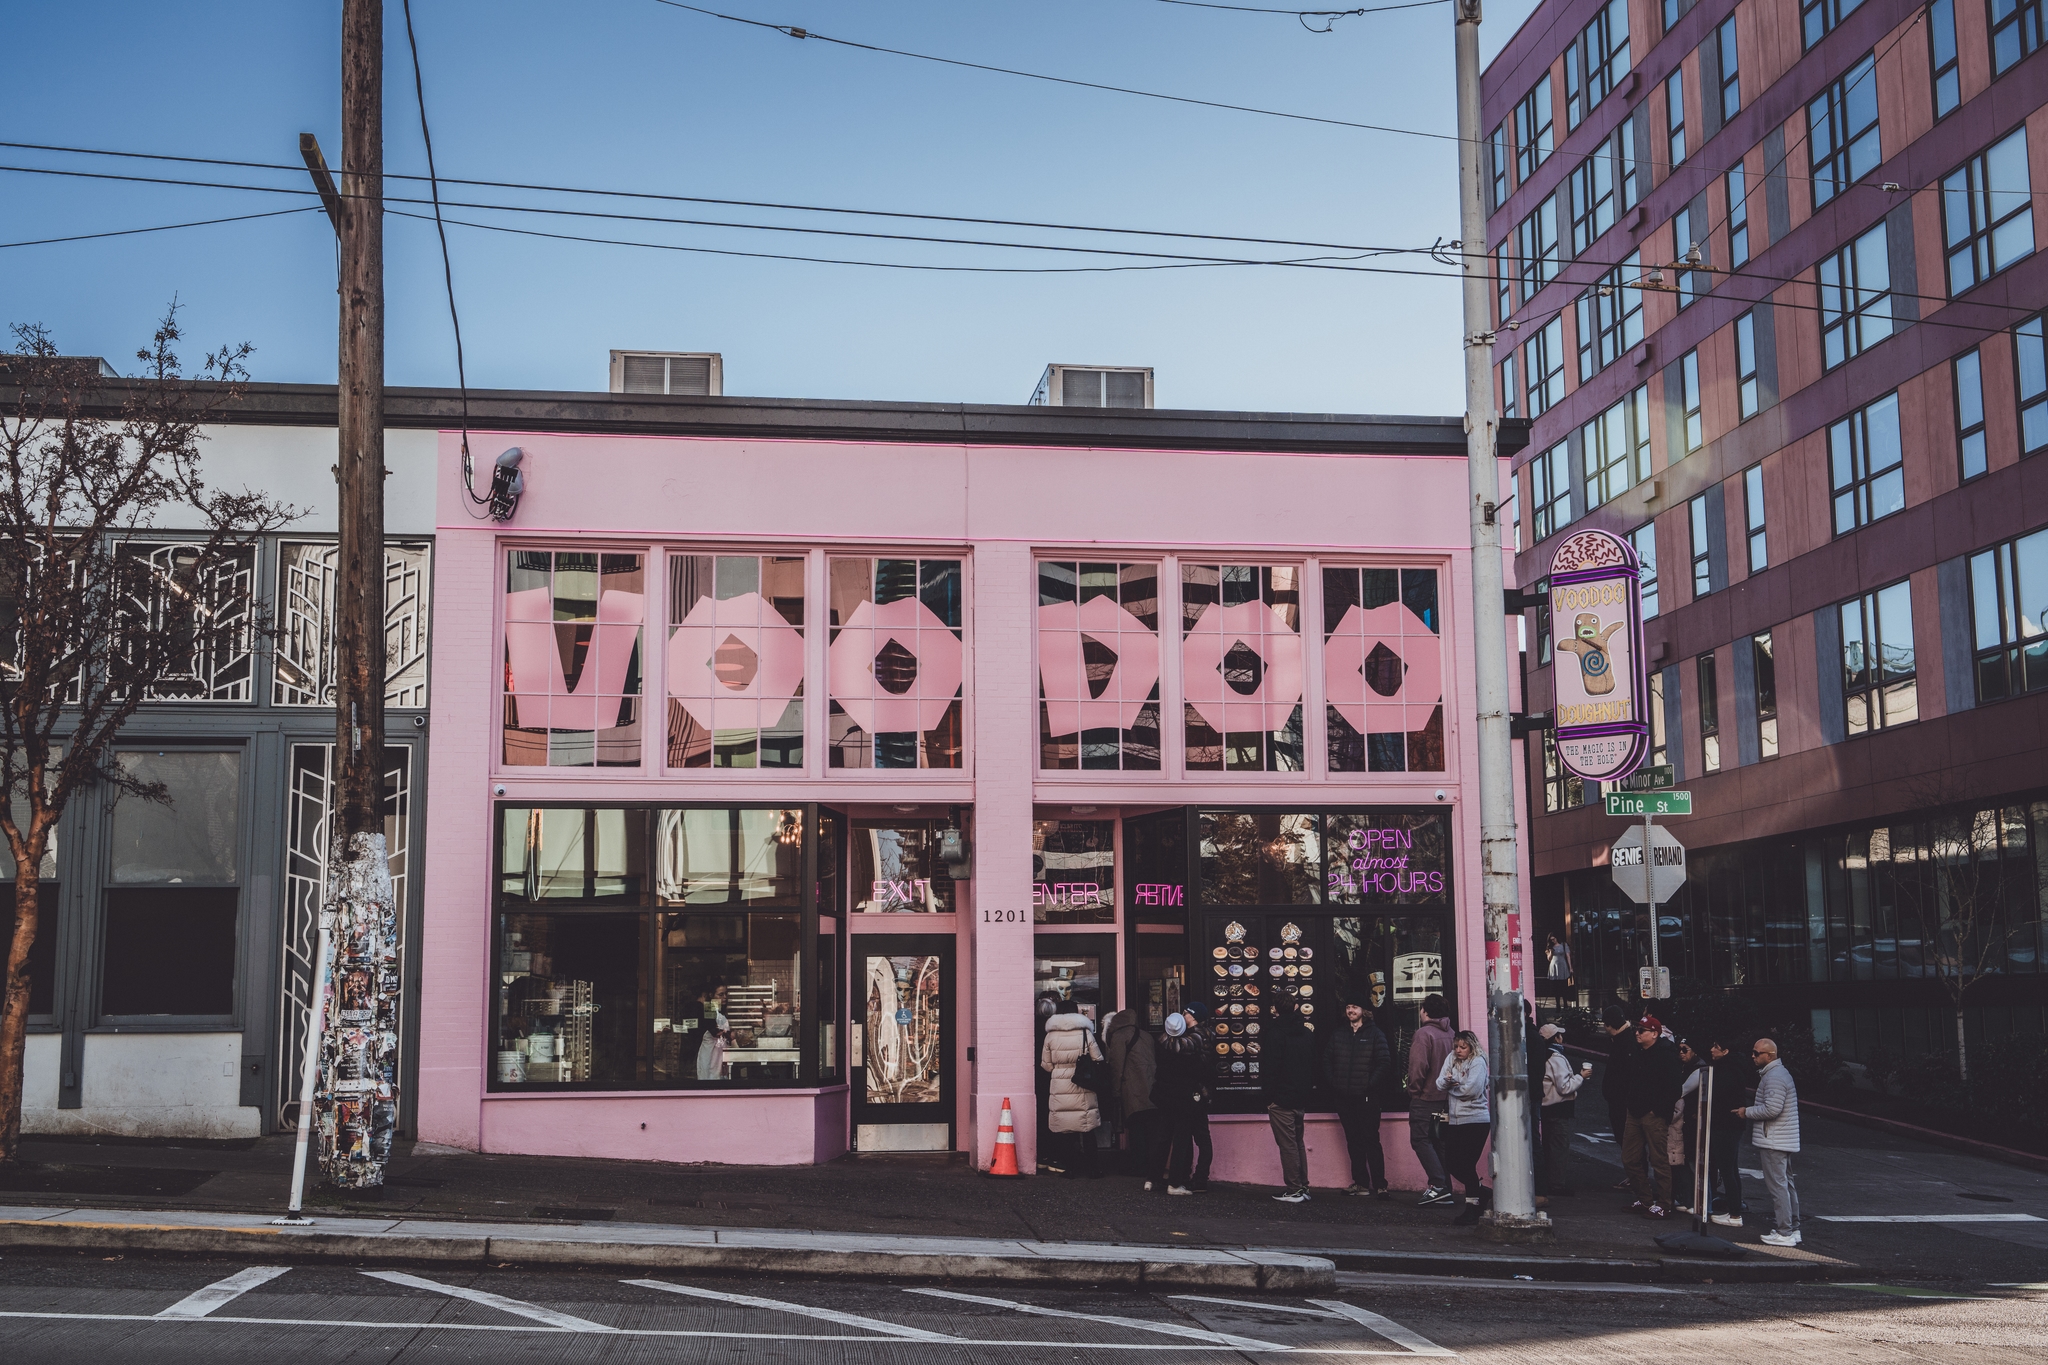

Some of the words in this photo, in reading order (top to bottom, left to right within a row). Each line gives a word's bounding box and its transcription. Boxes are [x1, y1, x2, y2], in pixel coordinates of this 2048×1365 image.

[1552, 583, 1626, 612] VOODOO
[1557, 700, 1631, 725] DOUGHNUT
[1565, 746, 1579, 756] THE
[1582, 743, 1604, 754] MAGIC
[1607, 742, 1615, 752] IS
[1619, 741, 1627, 751] IN
[1580, 756, 1593, 766] THE
[1597, 754, 1615, 765] HOLE
[1629, 773, 1651, 789] Minor
[1654, 774, 1665, 785] Ave
[1610, 796, 1644, 813] Pine
[1657, 801, 1668, 813] St
[1672, 792, 1689, 800] 1500
[1348, 829, 1412, 850] OPEN
[1352, 852, 1410, 869] almost
[1611, 846, 1643, 867] GENIE
[1654, 846, 1683, 867] REMAND
[872, 880, 931, 903] EXIT
[1327, 873, 1357, 895] 24
[1362, 871, 1444, 893] HOURS
[983, 910, 1027, 923] 1201
